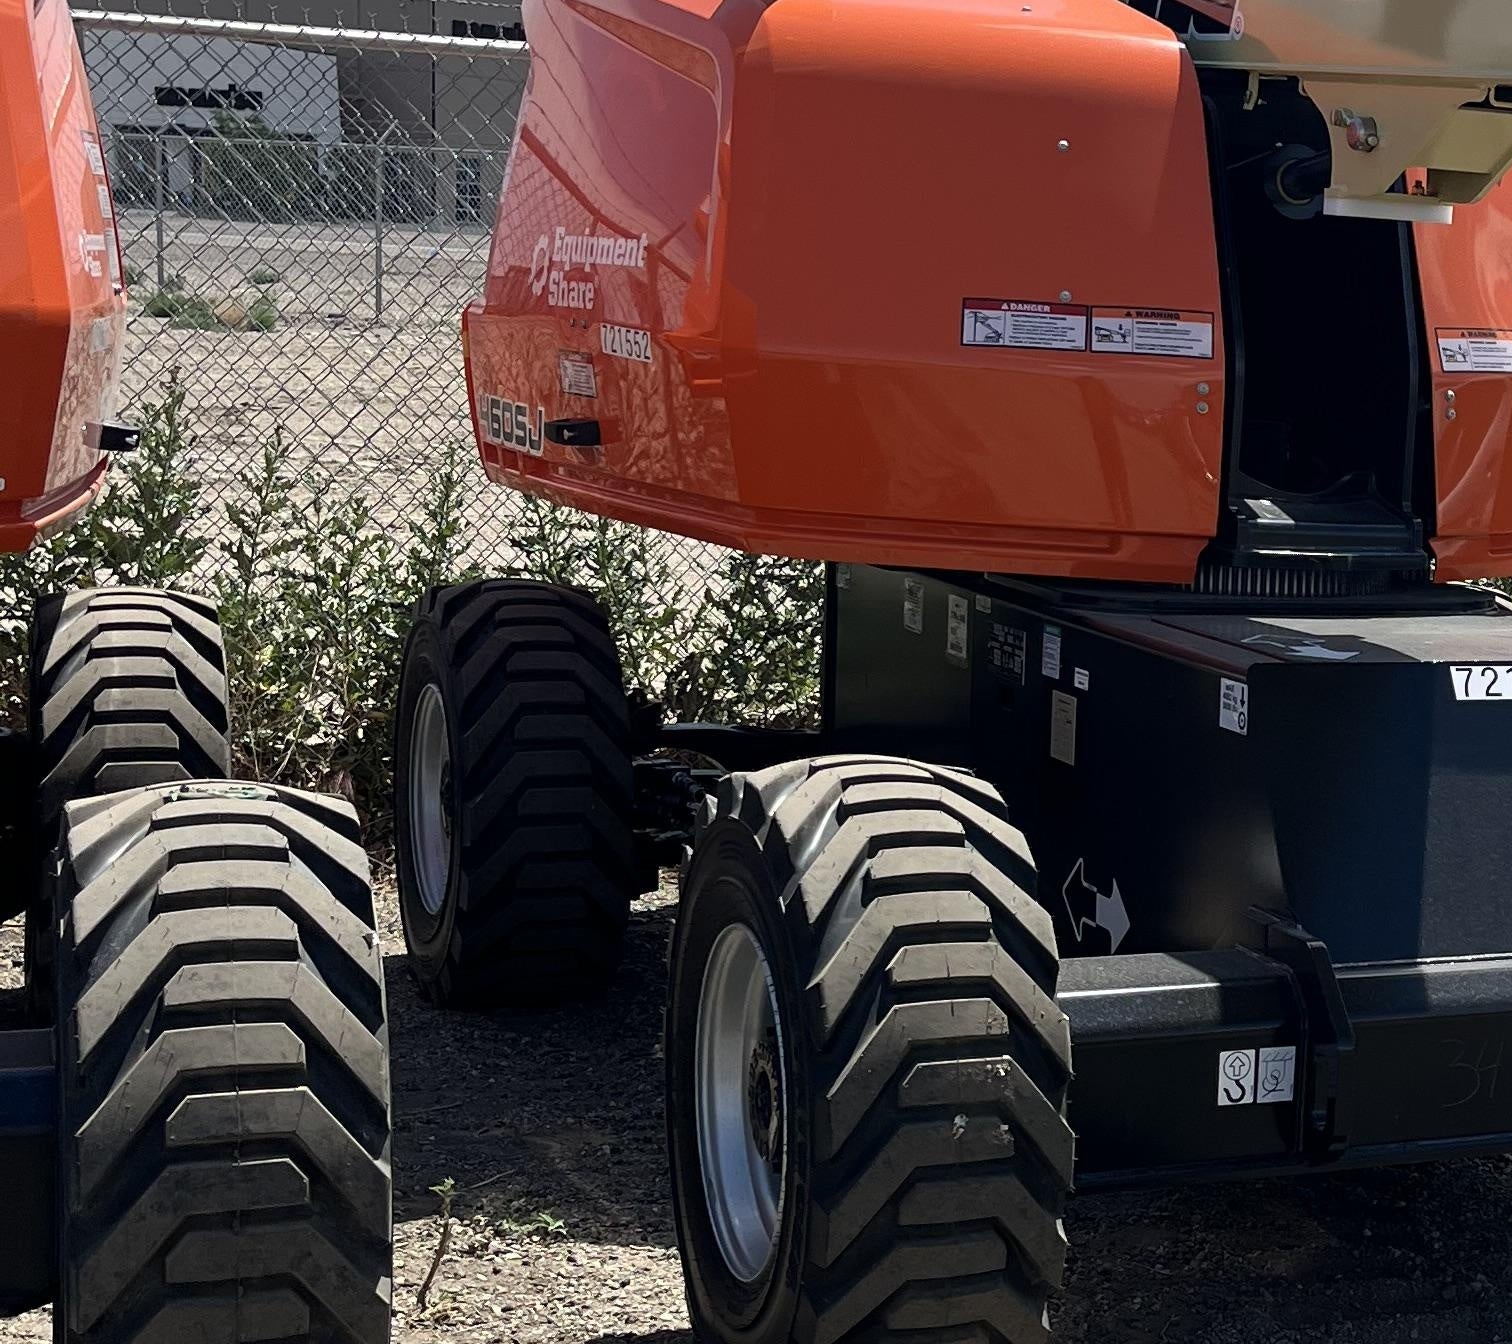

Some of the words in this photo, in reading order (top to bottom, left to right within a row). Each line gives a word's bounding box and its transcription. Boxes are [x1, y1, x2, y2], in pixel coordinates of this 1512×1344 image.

[551, 226, 648, 273] Equipment
[548, 270, 595, 310] Share
[1009, 303, 1051, 313] DANGER
[1135, 311, 1181, 320] WARNING
[602, 324, 651, 360] 721552
[479, 393, 545, 456] 460SJ
